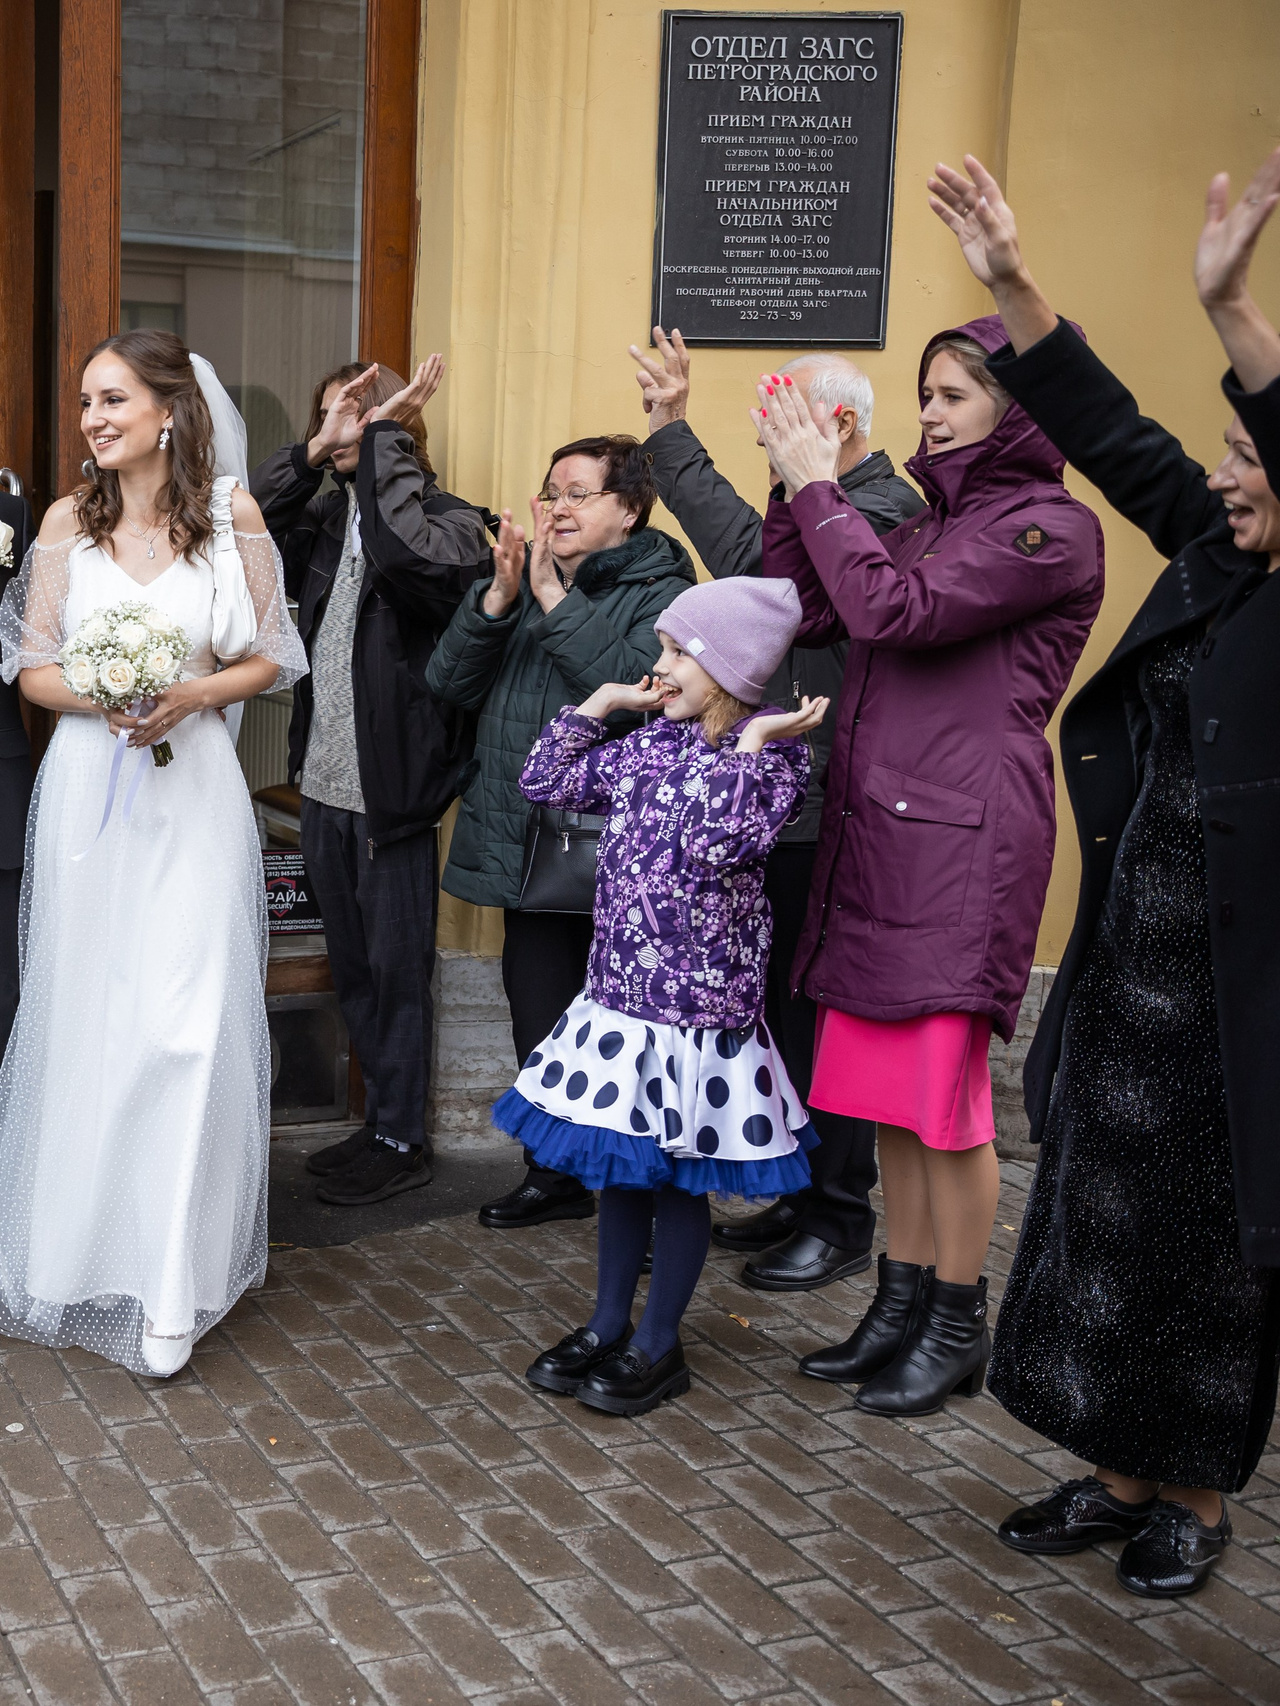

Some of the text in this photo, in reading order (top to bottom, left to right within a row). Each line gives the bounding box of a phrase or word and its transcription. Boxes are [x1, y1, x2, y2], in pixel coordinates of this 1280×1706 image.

[690, 36, 874, 63] ОТДЕЛ ЗАГС
[687, 64, 877, 84] ПЕТРОГРАДСКОГО
[738, 82, 822, 102] РАЙОНА
[707, 114, 852, 130] ПРИЕМ ГРАЖДАН
[700, 135, 796, 145] ВТОРНИК-ПЯТНИЦА
[725, 149, 769, 158] СУББОТА
[724, 163, 770, 172] ПЕРЕРЫВ
[704, 180, 851, 195] ПРИЕМ ГРАЖДАН
[716, 197, 838, 212] НАЧАЛЬНИКОМ
[719, 214, 833, 228] ОТДЕЛА ЗАГС
[723, 235, 767, 244] ВТОРНИК
[722, 249, 765, 258] ЧЕТВЕРГ
[855, 267, 882, 276] ДЕНЬ
[725, 275, 791, 285] САНИТАРНЫЙ
[676, 287, 868, 298] ПОСЛЕДНИЙ РАБОЧИЙ ДЕНЬ КВАРТАЛА
[710, 299, 756, 308] ТЕЛЕФОН
[760, 299, 798, 309] ОТДЕЛА
[267, 902, 294, 910] security
